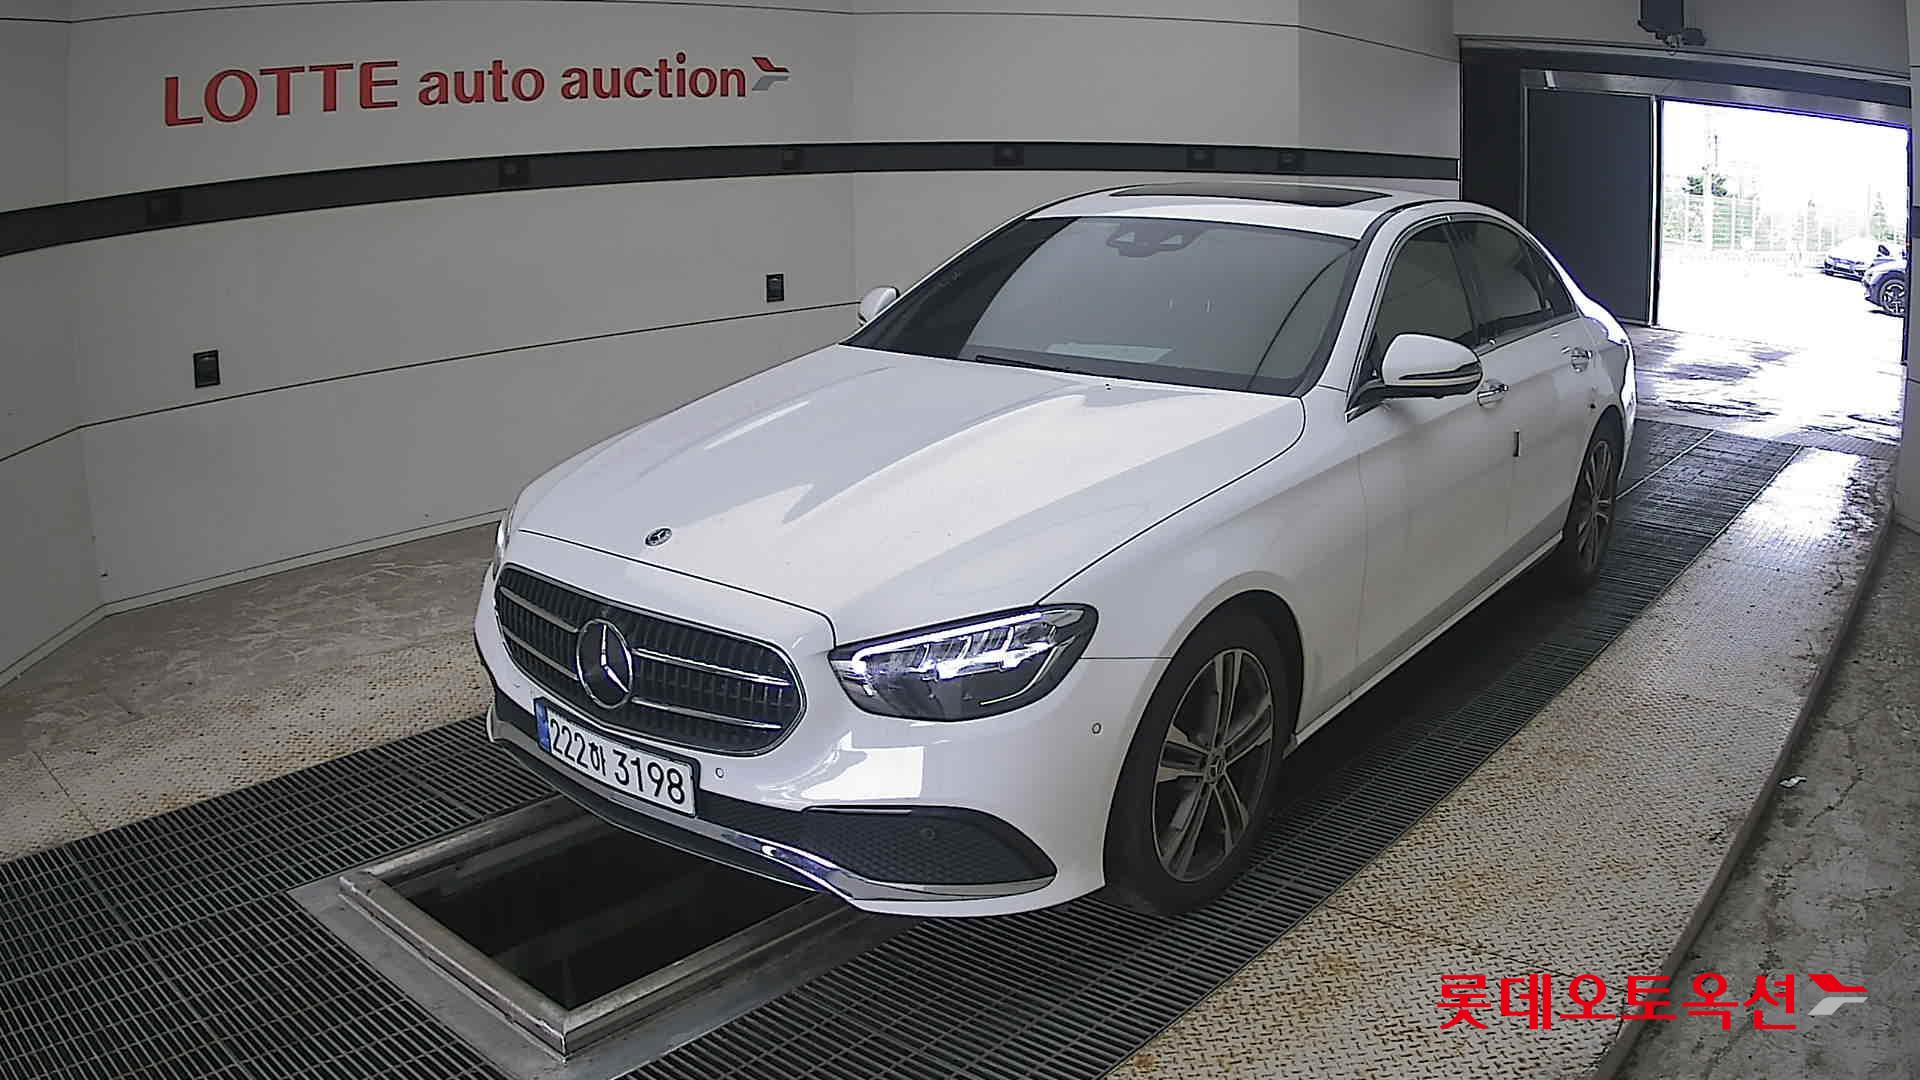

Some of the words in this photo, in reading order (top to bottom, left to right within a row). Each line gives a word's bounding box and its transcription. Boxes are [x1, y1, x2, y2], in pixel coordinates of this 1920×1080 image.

[164, 60, 399, 127] LOTTE
[418, 59, 545, 106] auto
[561, 52, 747, 100] auction
[612, 749, 685, 804] 3198
